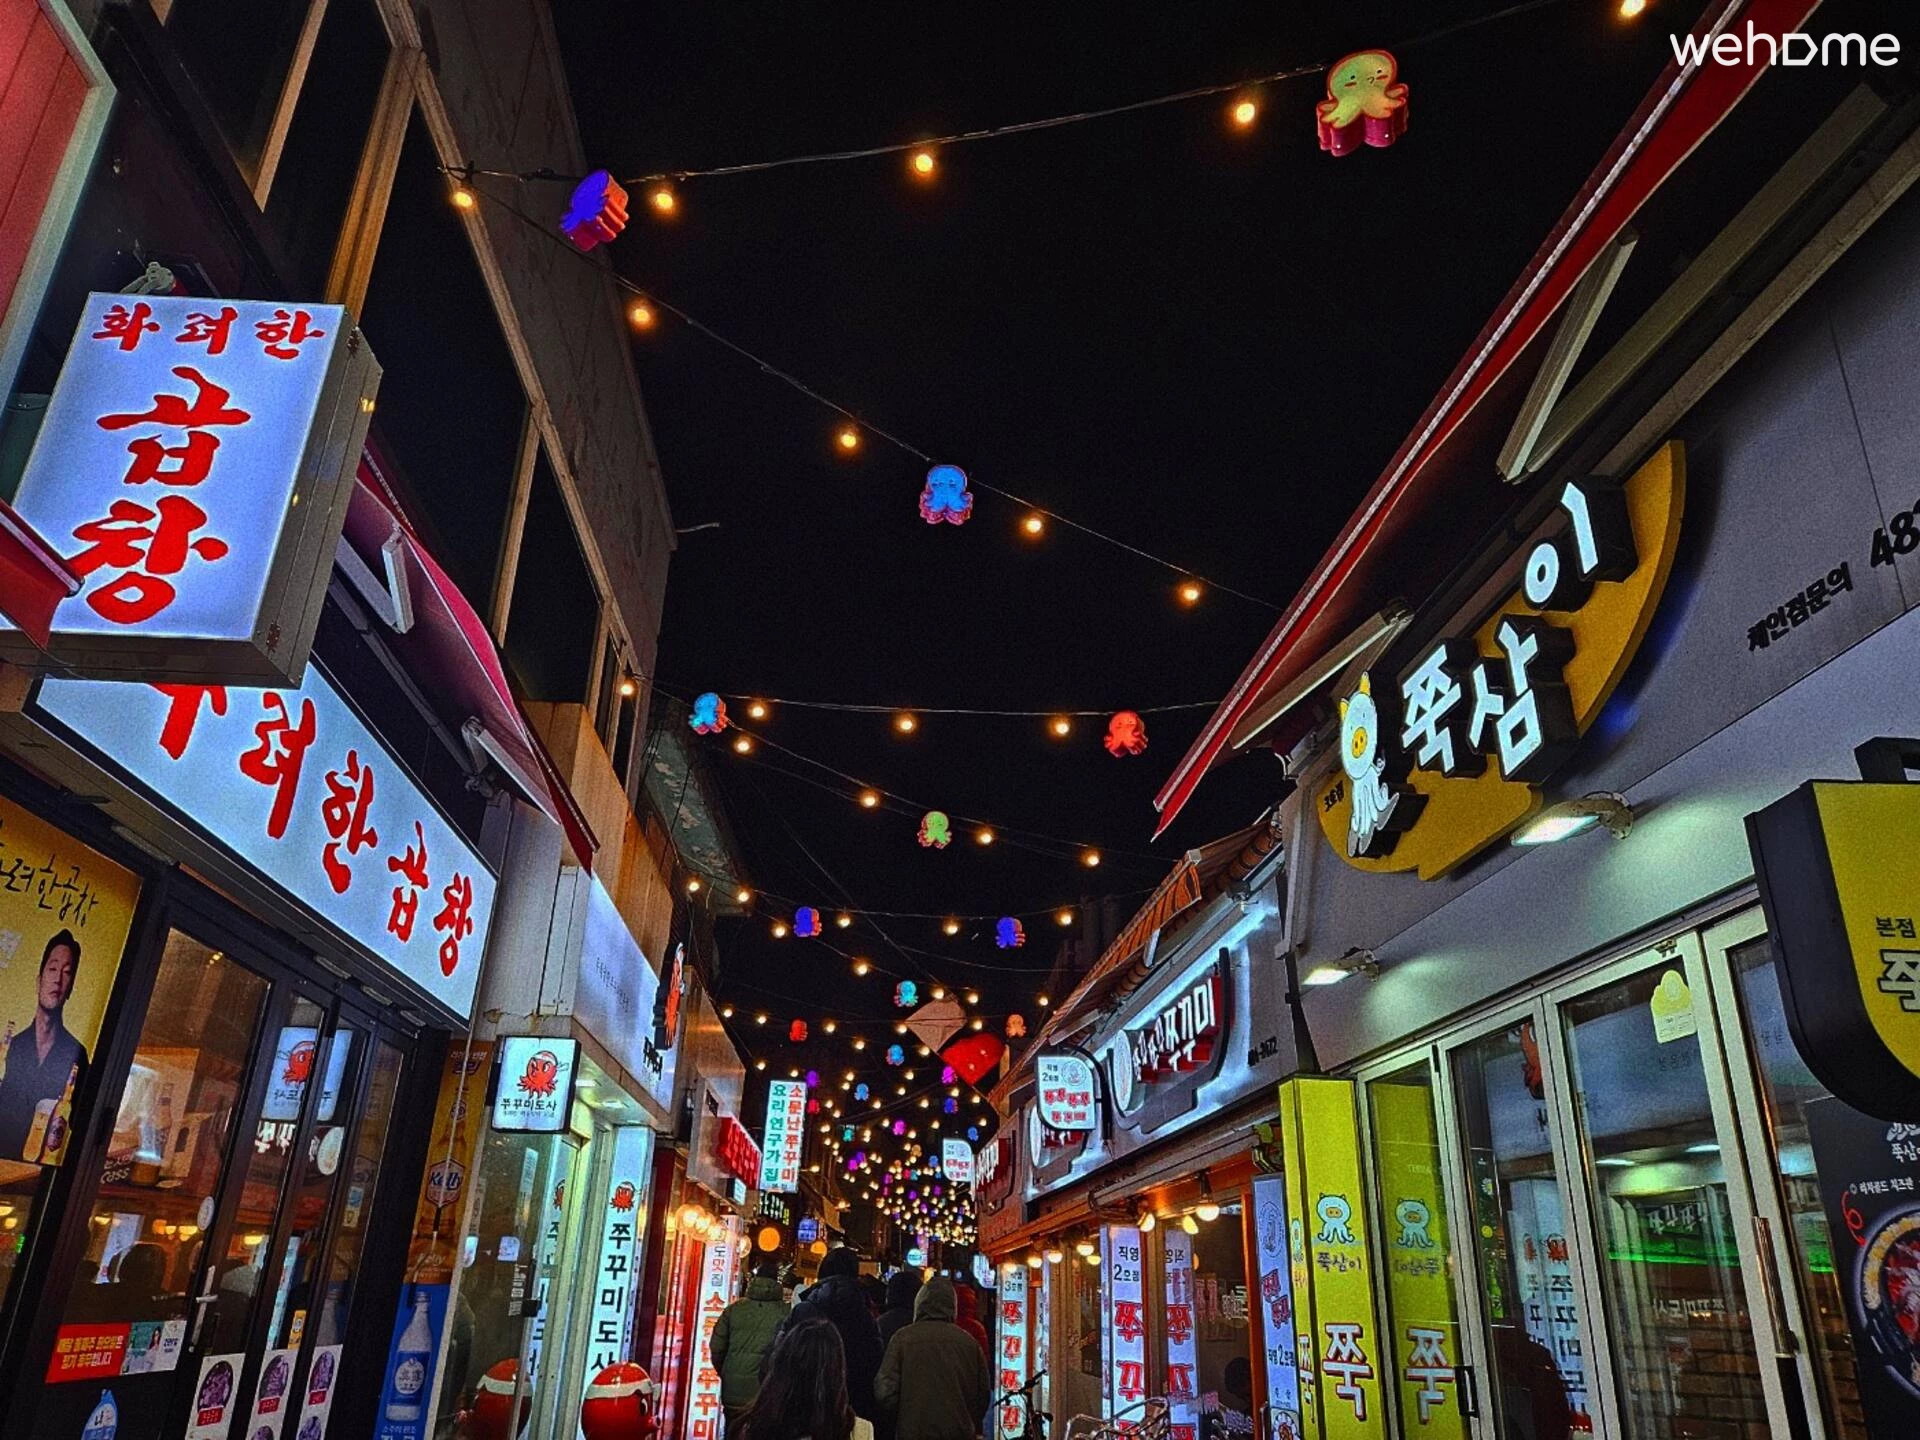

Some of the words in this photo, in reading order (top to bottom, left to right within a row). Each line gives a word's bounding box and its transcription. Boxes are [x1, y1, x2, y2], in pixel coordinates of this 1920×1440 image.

[91, 302, 326, 360] 화려한
[65, 366, 252, 624] 곱창
[1402, 480, 1599, 778] 쭉삼이
[1876, 917, 1916, 938] 본점
[764, 1084, 787, 1181] 요리연구가집
